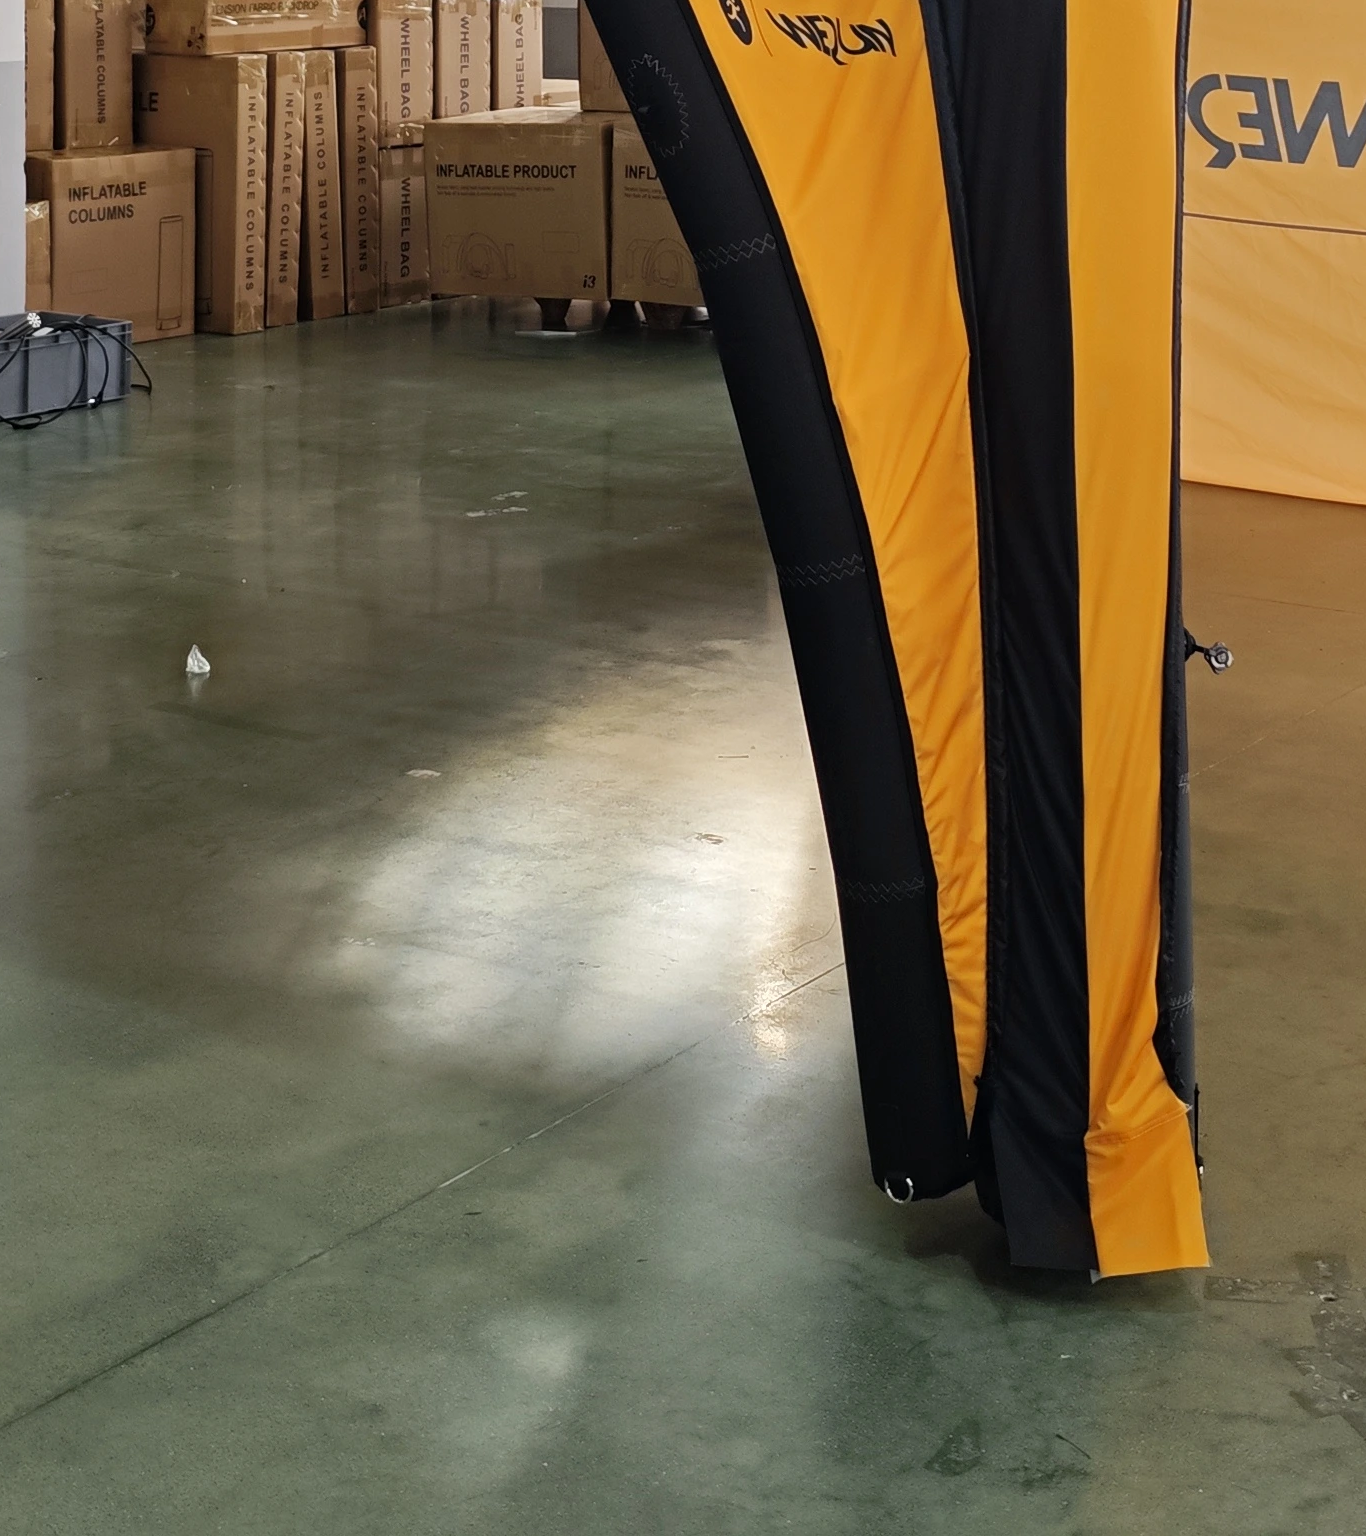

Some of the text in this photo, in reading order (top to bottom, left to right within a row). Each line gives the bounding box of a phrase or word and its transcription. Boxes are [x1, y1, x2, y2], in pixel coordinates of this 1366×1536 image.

[400, 18, 411, 119] WHEEL BAG
[460, 15, 471, 114] WHEEL BAG
[514, 13, 525, 49] BAG
[765, 7, 898, 66] WERUN
[96, 64, 107, 124] COLUMNS
[68, 180, 147, 202] INFLATABLE
[245, 95, 257, 291] INFLATABLE COLUMNS
[278, 92, 294, 284] INFLATABLE COLUMNS
[314, 91, 329, 279] INFLATABLE COLUMNS
[356, 86, 367, 272] INFLATABLE COLUMNS
[435, 163, 577, 179] INFLATABLE PRODUCT
[624, 164, 658, 180] INFL
[68, 203, 135, 225] COLUMNS
[400, 177, 411, 278] WHEEL BAG
